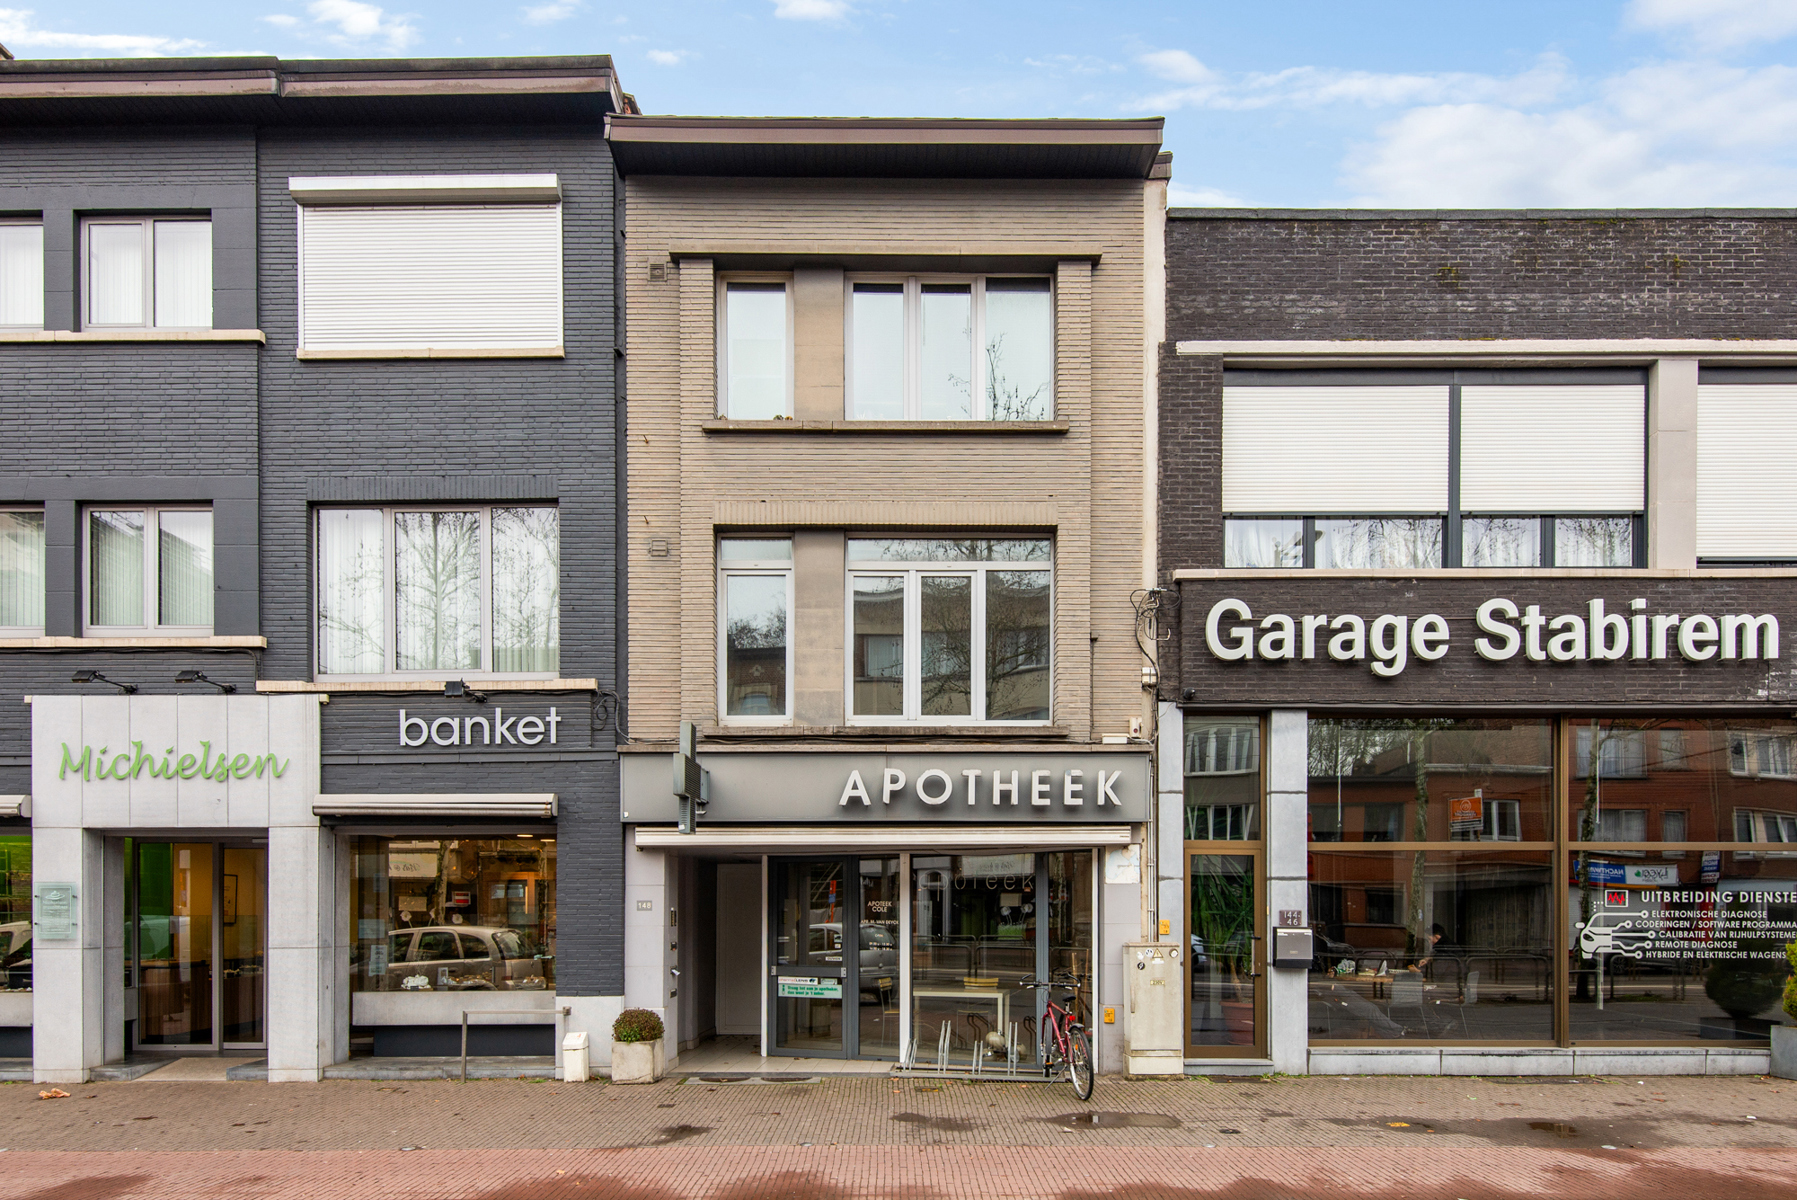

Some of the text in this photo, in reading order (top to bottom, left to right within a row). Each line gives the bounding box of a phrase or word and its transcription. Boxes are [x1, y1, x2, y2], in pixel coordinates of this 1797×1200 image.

[1205, 598, 1780, 678] Garage Stabirem
[399, 706, 562, 747] banket
[58, 741, 290, 783] Michielsen
[838, 768, 1123, 806] APOTHEEK
[919, 868, 1034, 902] apoteek
[1641, 891, 1797, 903] UITBREIDING DIENSTE
[1651, 910, 1768, 919] ELEKTRONISCHE DIAGNOSE
[1635, 920, 1690, 928] CODERINGEN
[1698, 920, 1740, 929] SOFTWARE
[1658, 930, 1706, 938] CALIBRATIE
[1708, 930, 1727, 938] VAN
[1691, 941, 1738, 949] DIAGNOSE
[1645, 951, 1787, 959] HYBRIDE EN ELEKTRISCHE WAGENS
